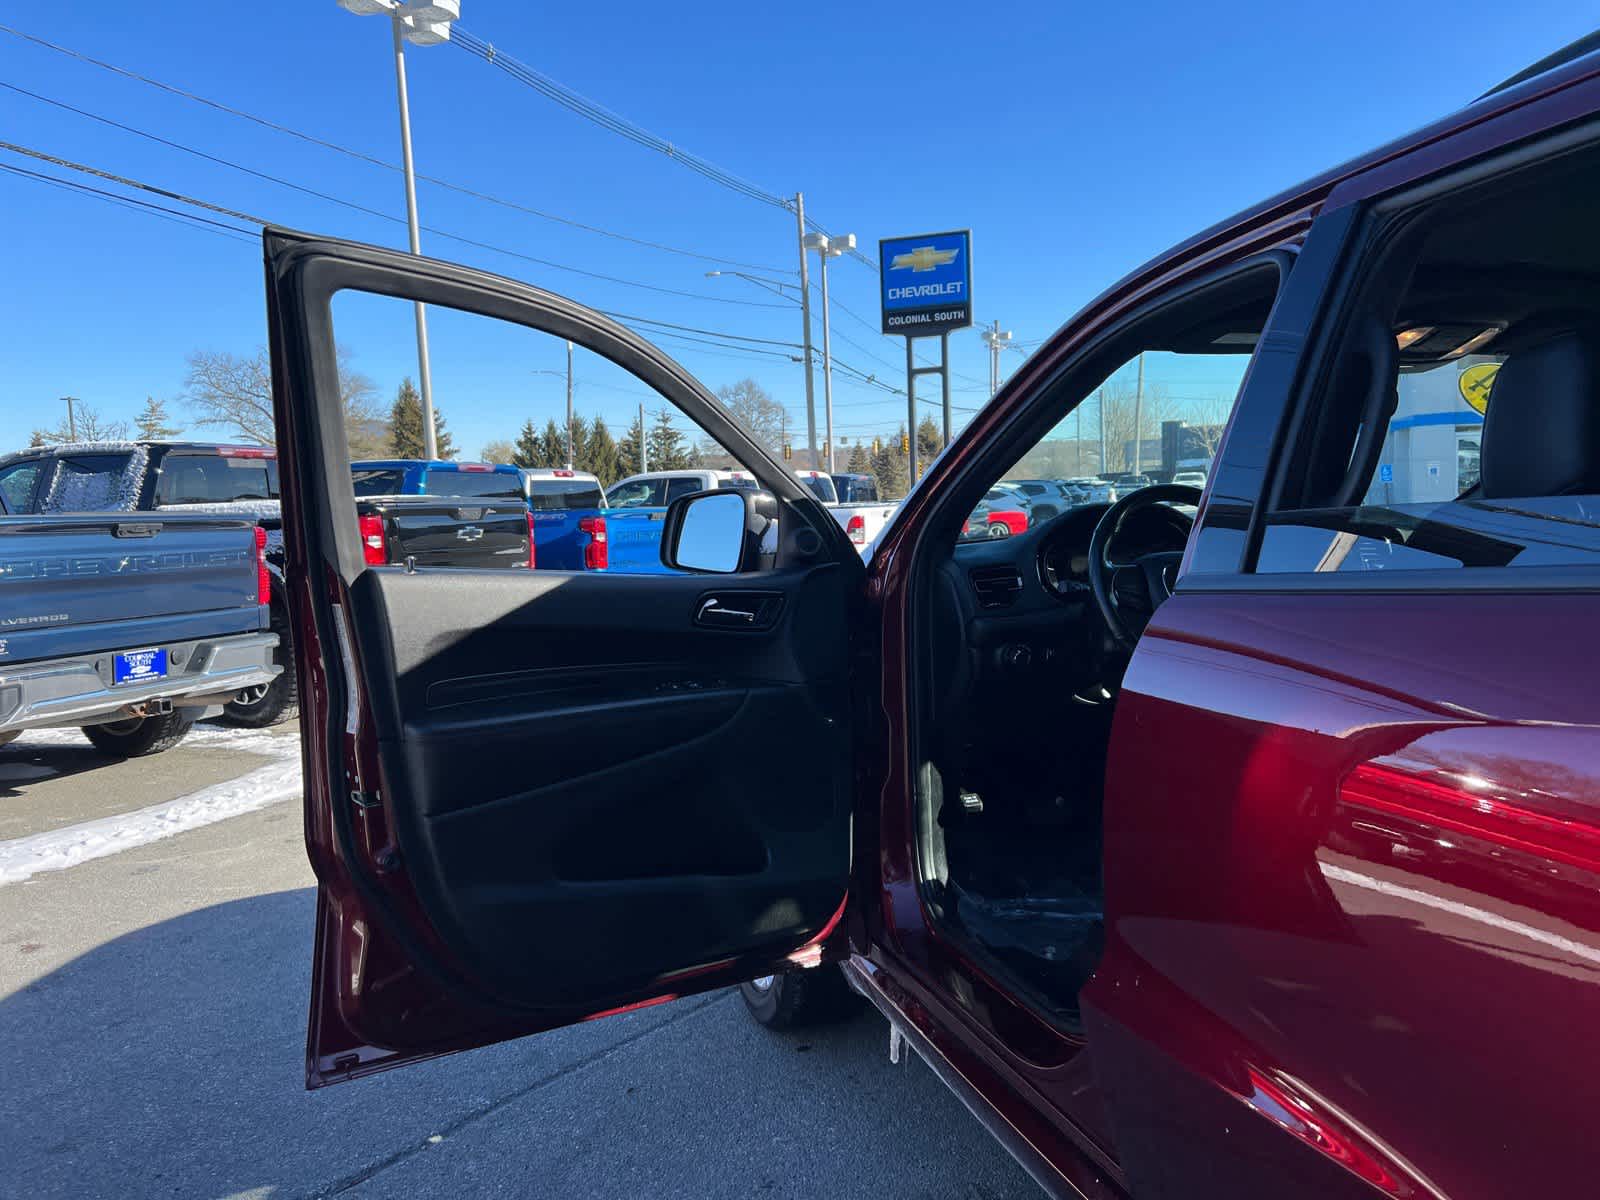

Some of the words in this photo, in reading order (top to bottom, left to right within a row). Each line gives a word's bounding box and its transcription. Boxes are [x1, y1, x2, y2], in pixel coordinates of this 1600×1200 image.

[888, 282, 963, 300] CHEVROLET
[888, 313, 932, 326] COLONIAL
[934, 310, 965, 321] SOUTH
[1, 551, 249, 579] CHEVROLET
